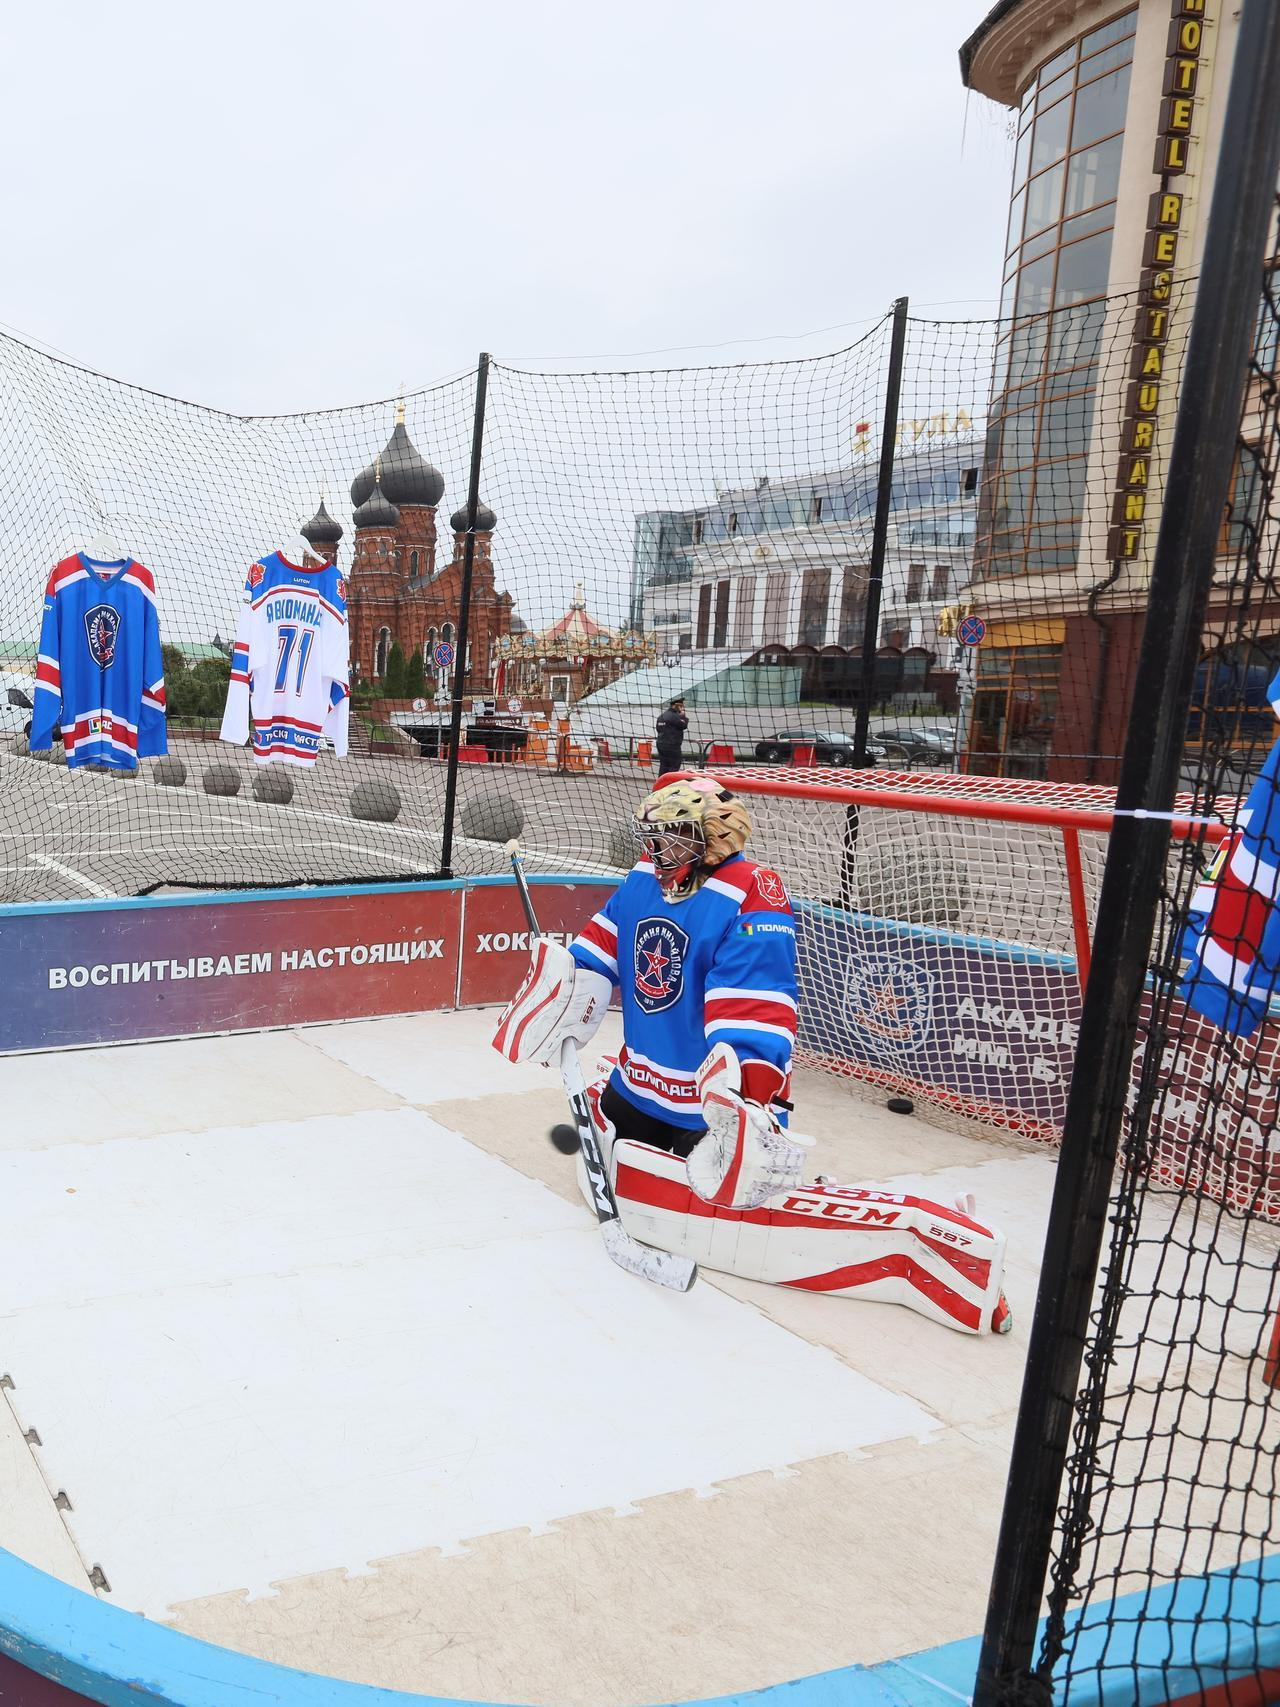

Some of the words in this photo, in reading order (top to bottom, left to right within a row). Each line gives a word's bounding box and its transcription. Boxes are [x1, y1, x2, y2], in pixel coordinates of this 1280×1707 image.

[1123, 194, 1181, 557] RESTAURANT
[274, 624, 315, 698] 71
[48, 952, 272, 990] ВОСПИТЫВАЕМ
[280, 938, 445, 971] НАСТОЯЩИХ
[782, 1196, 902, 1226] CCM
[929, 1227, 972, 1247] 597
